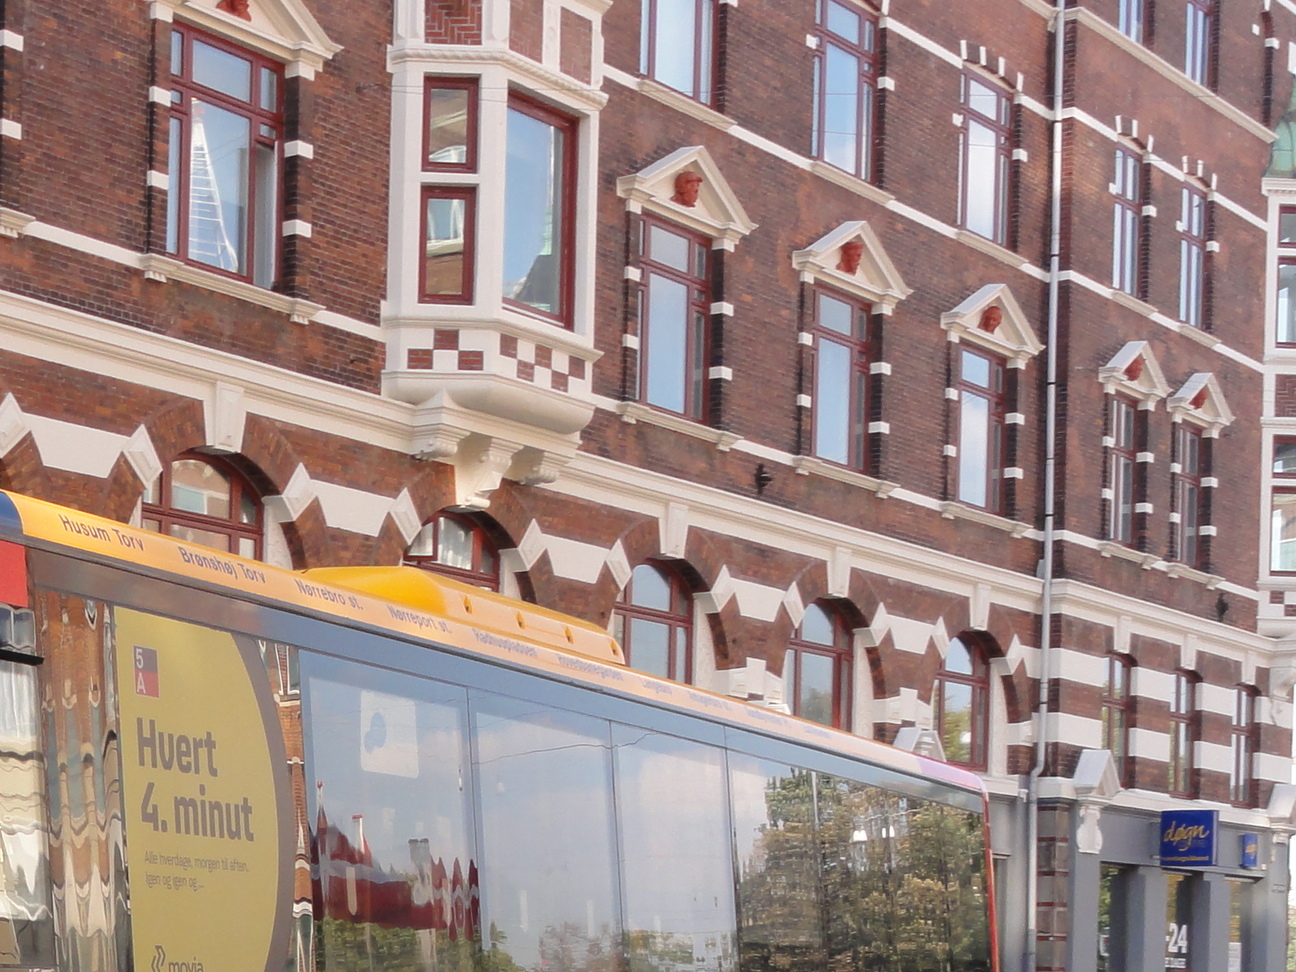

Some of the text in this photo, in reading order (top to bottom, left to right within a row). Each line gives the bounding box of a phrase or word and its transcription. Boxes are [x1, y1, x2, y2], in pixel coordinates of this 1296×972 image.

[58, 513, 145, 551] Husum Torv
[178, 547, 267, 584] Brønshøj Torv
[294, 578, 364, 611] Nørrebro st.
[136, 649, 144, 669] 5
[137, 672, 146, 694] A
[136, 717, 218, 777] Hvert
[141, 782, 254, 842] 4. minut
